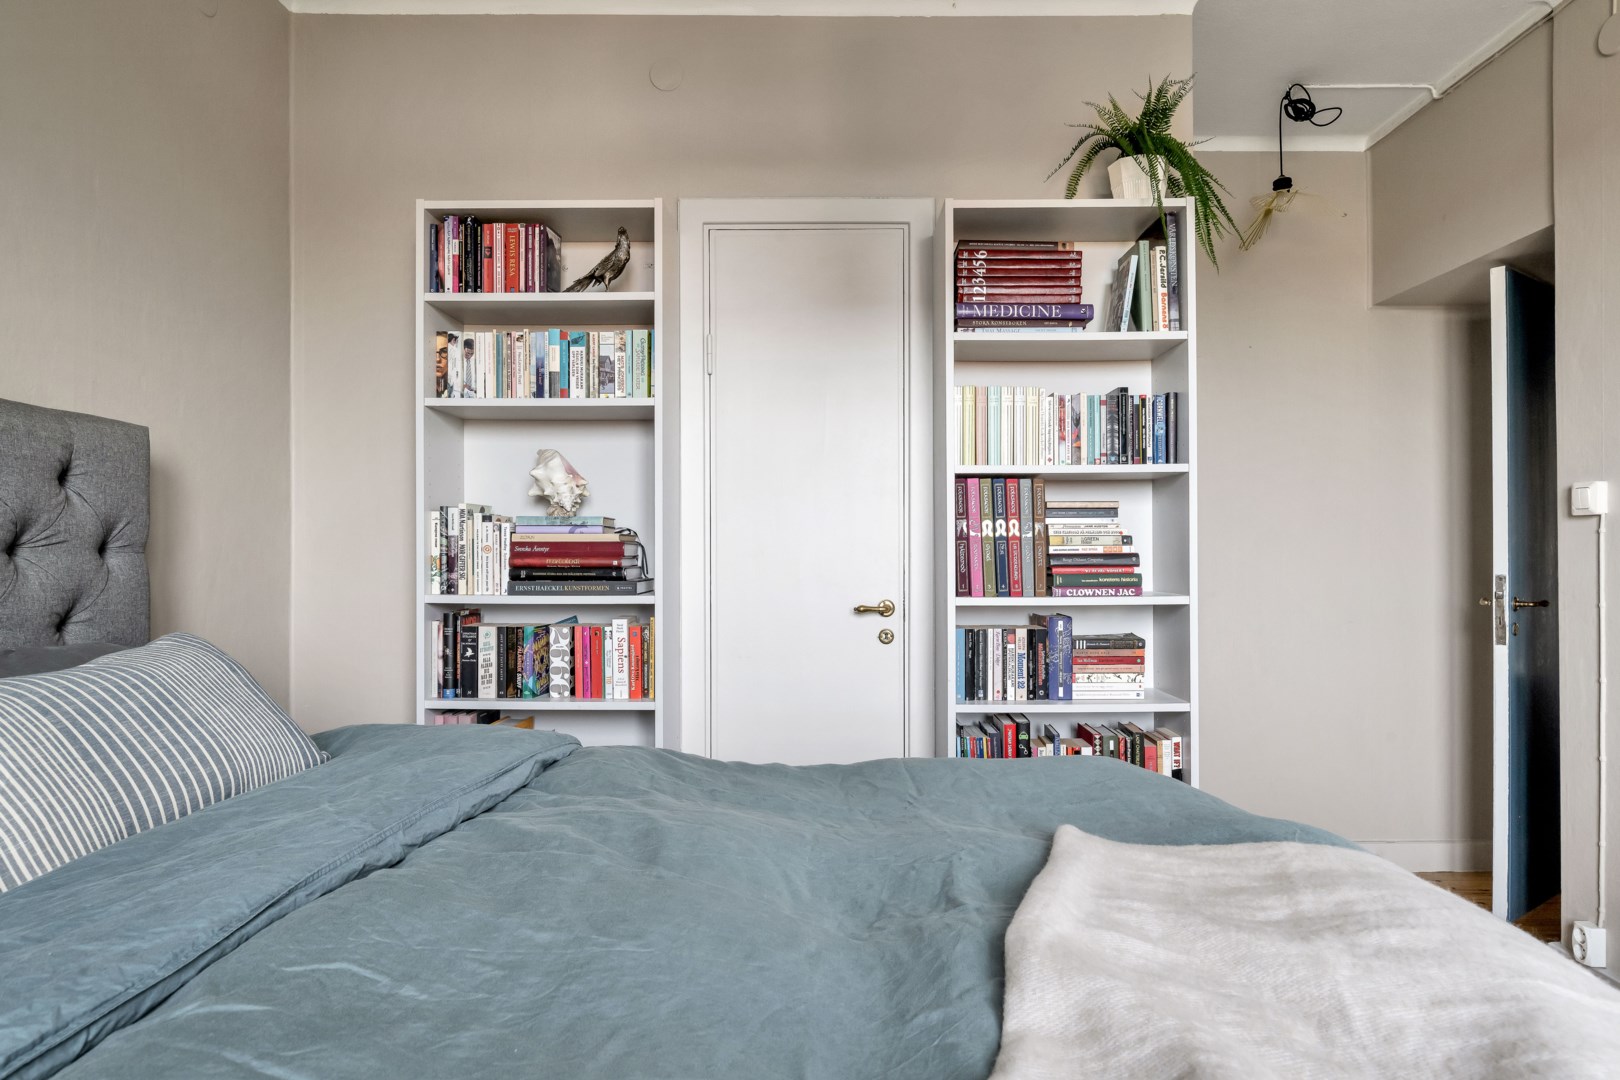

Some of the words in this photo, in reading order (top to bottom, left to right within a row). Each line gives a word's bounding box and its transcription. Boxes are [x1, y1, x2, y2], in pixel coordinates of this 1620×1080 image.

[973, 304, 1062, 318] MEDICINE
[550, 627, 570, 698] 2666
[615, 637, 626, 674] Sapiens
[1018, 681, 1026, 689] 22
